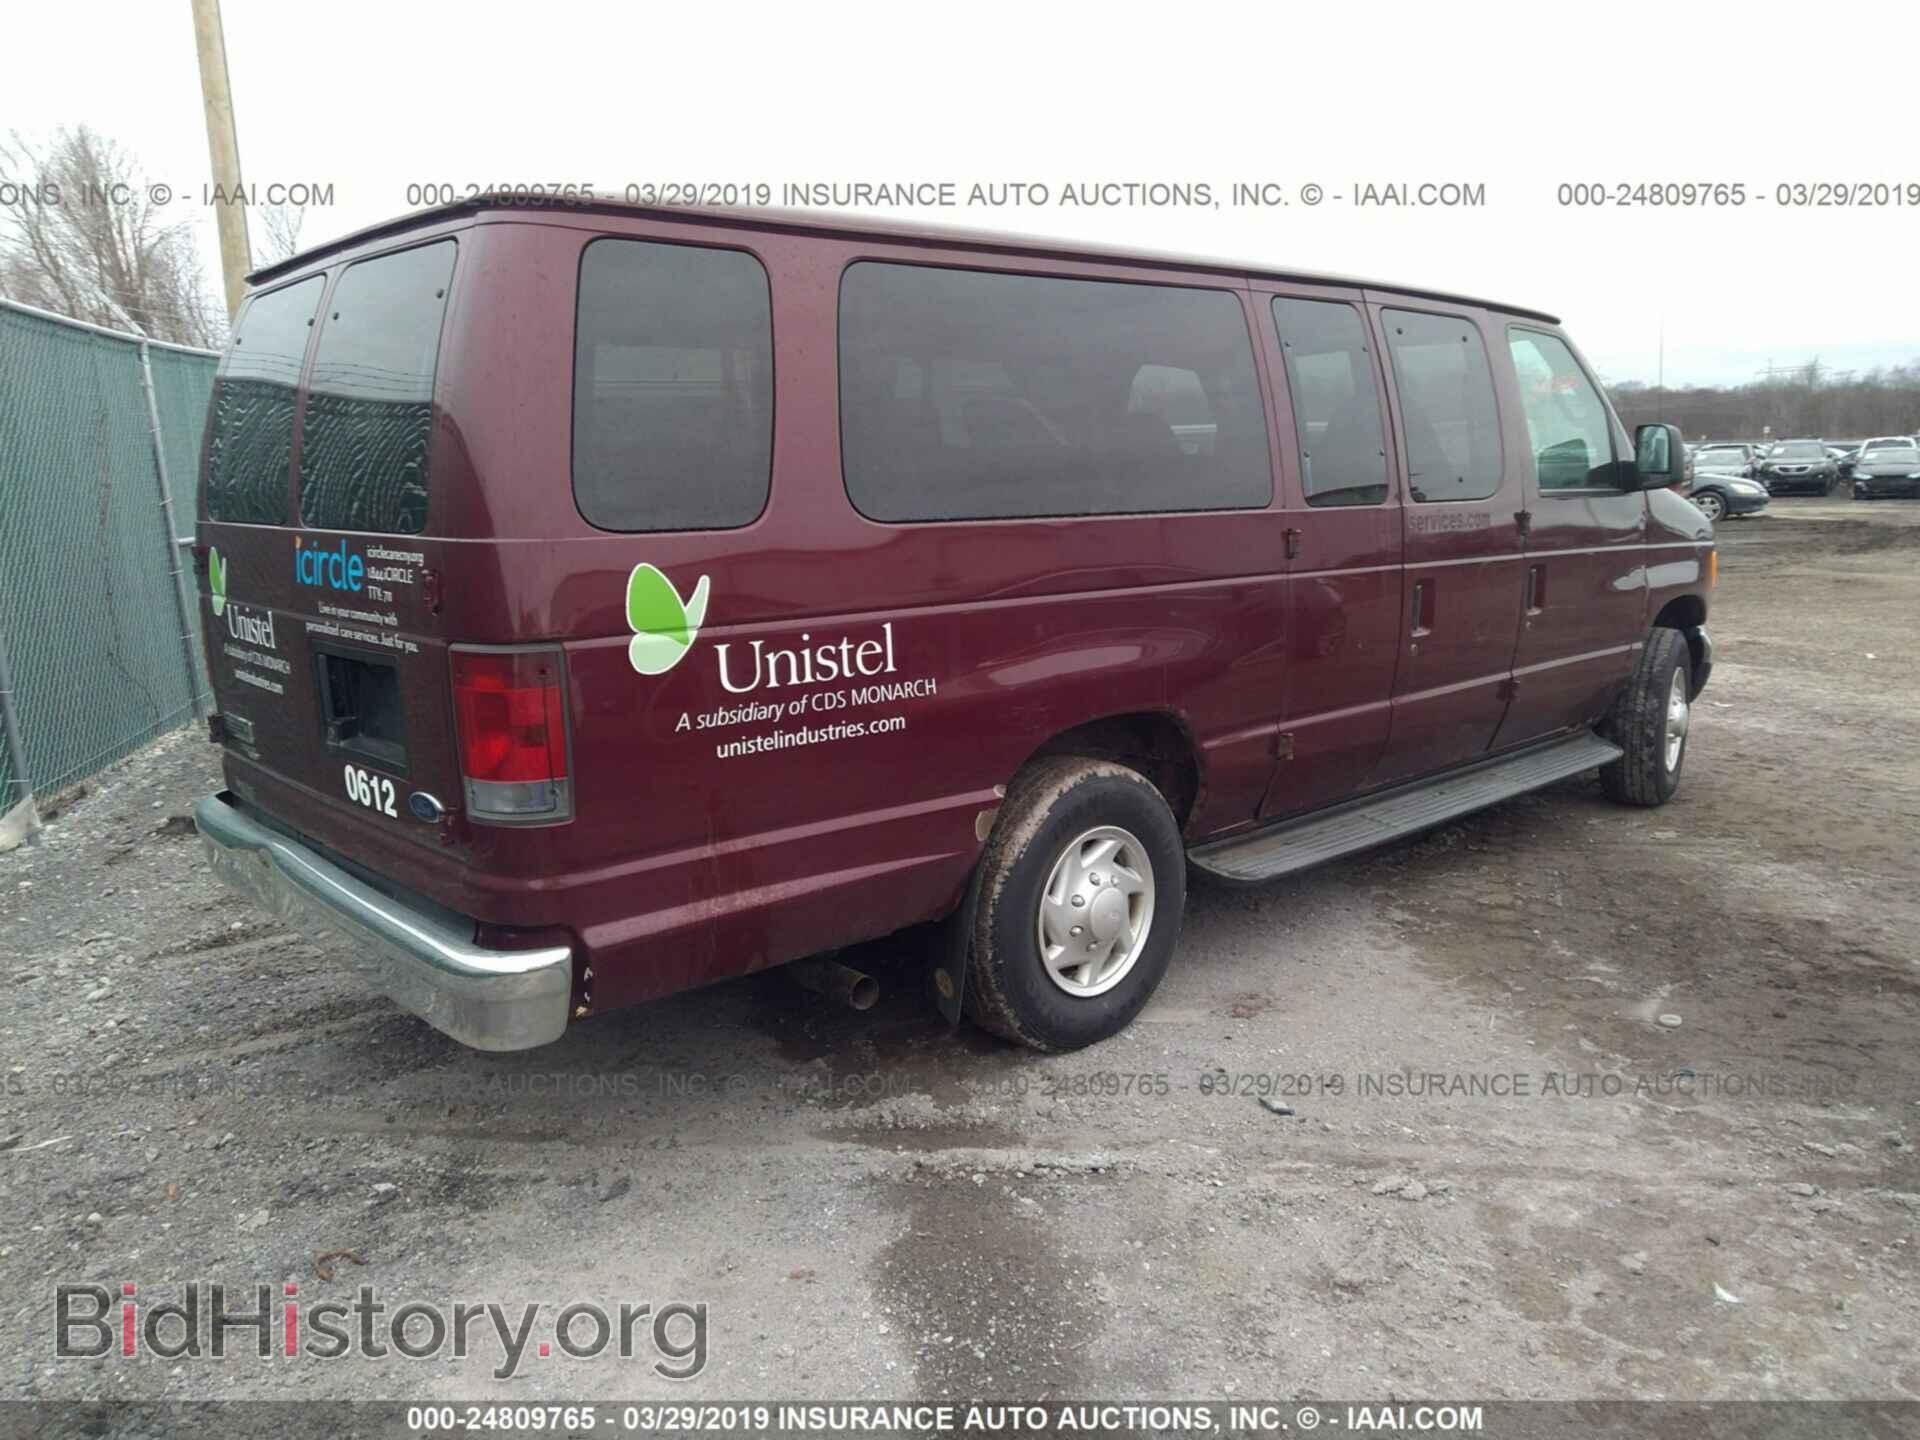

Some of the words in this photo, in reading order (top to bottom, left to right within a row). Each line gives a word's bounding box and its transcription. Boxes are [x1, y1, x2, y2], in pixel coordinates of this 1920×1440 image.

[225, 603, 276, 649] Unistel
[714, 622, 897, 694] Unistel
[675, 712, 691, 733] A
[696, 699, 785, 730] subsidiary
[788, 694, 809, 716] of
[811, 690, 847, 712] CDS
[851, 677, 937, 706] MONARCH
[716, 714, 906, 758] unistelindustries.com
[344, 764, 398, 819] 0612
